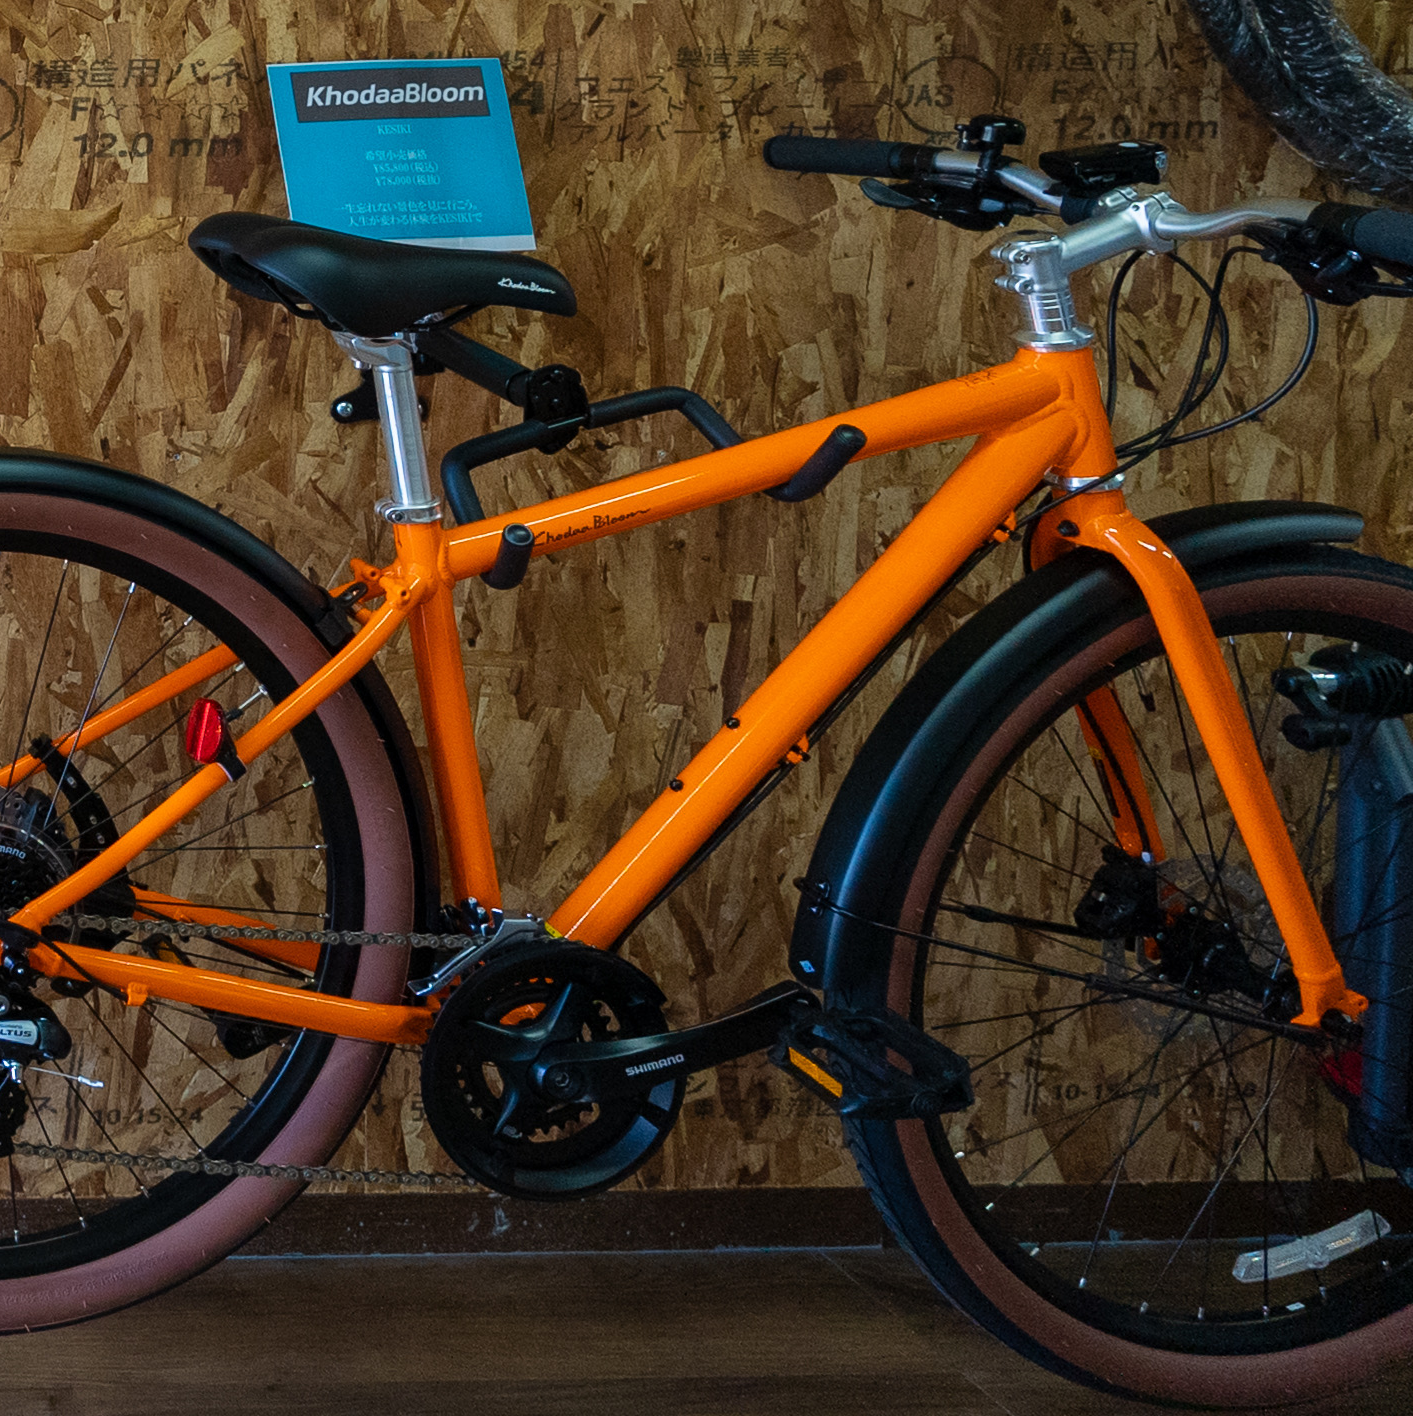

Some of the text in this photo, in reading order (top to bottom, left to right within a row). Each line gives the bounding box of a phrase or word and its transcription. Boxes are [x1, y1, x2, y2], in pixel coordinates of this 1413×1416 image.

[305, 82, 485, 108] KhodaaBloom
[377, 124, 413, 136] KESIKI
[74, 133, 243, 159] 12.0 mm
[625, 1053, 685, 1077] SHIMANO
